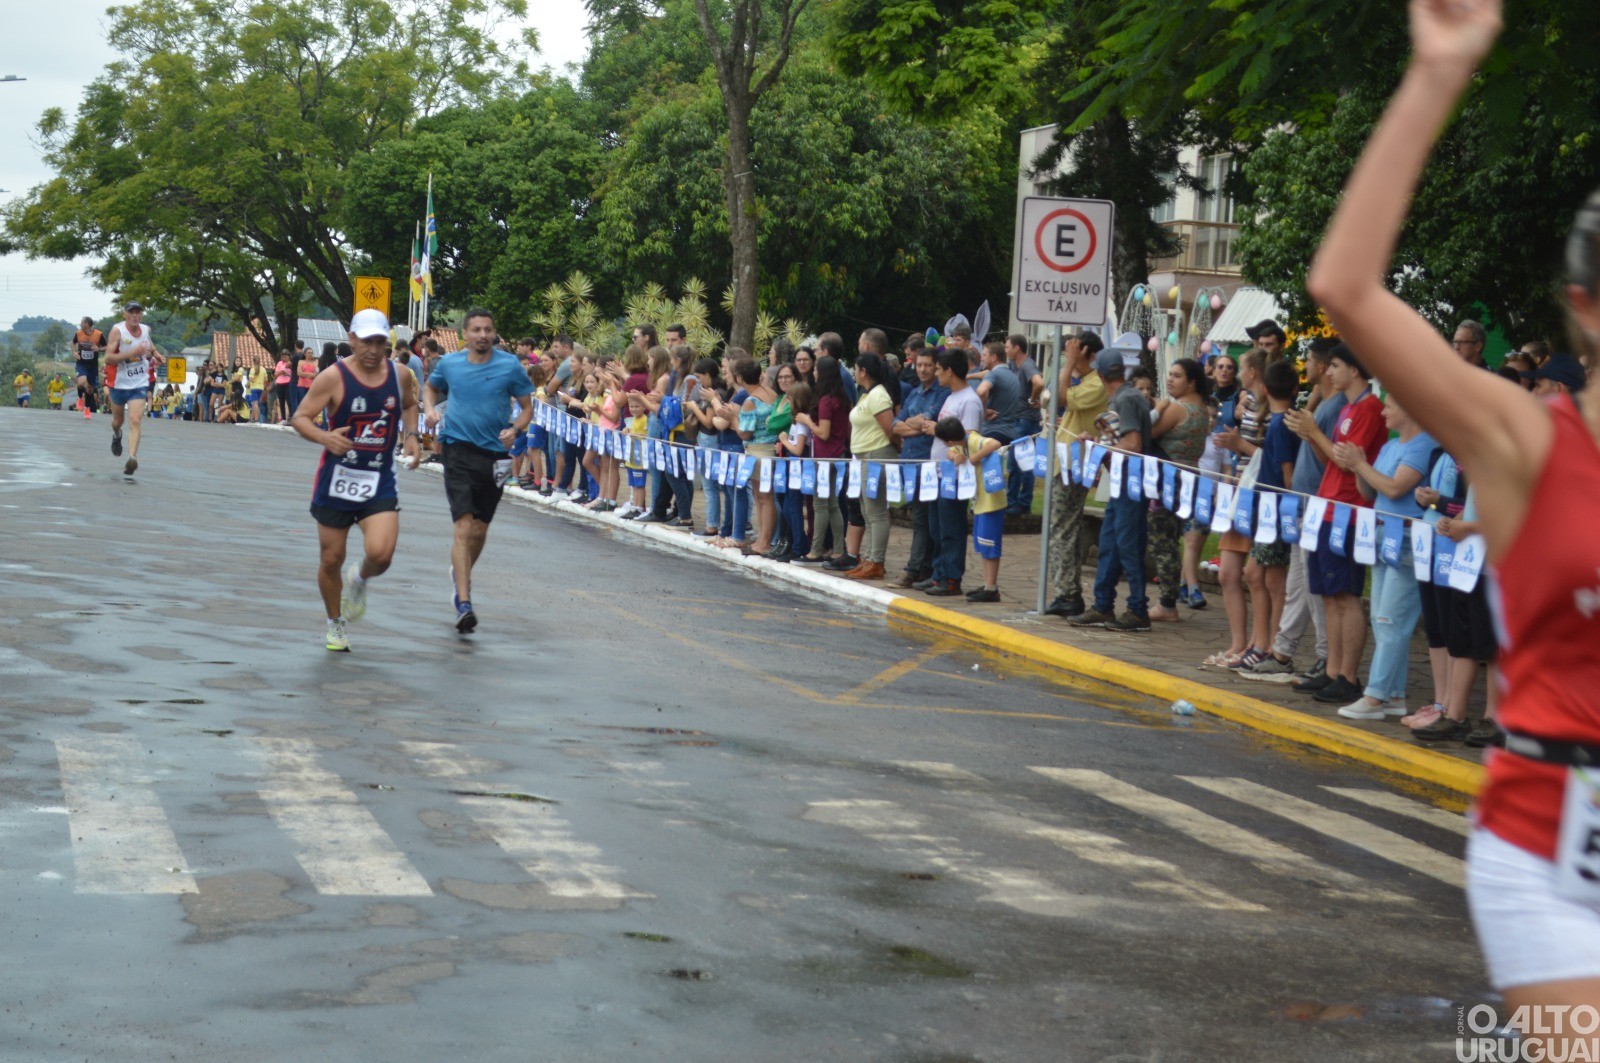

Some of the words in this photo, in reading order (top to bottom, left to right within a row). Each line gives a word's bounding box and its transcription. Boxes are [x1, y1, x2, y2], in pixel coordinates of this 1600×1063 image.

[1055, 224, 1076, 257] E
[1025, 280, 1100, 296] EXCLUSIVO
[1048, 296, 1077, 313] TÁXI
[127, 366, 144, 377] 644
[355, 420, 387, 438] TAG
[334, 478, 372, 499] 662
